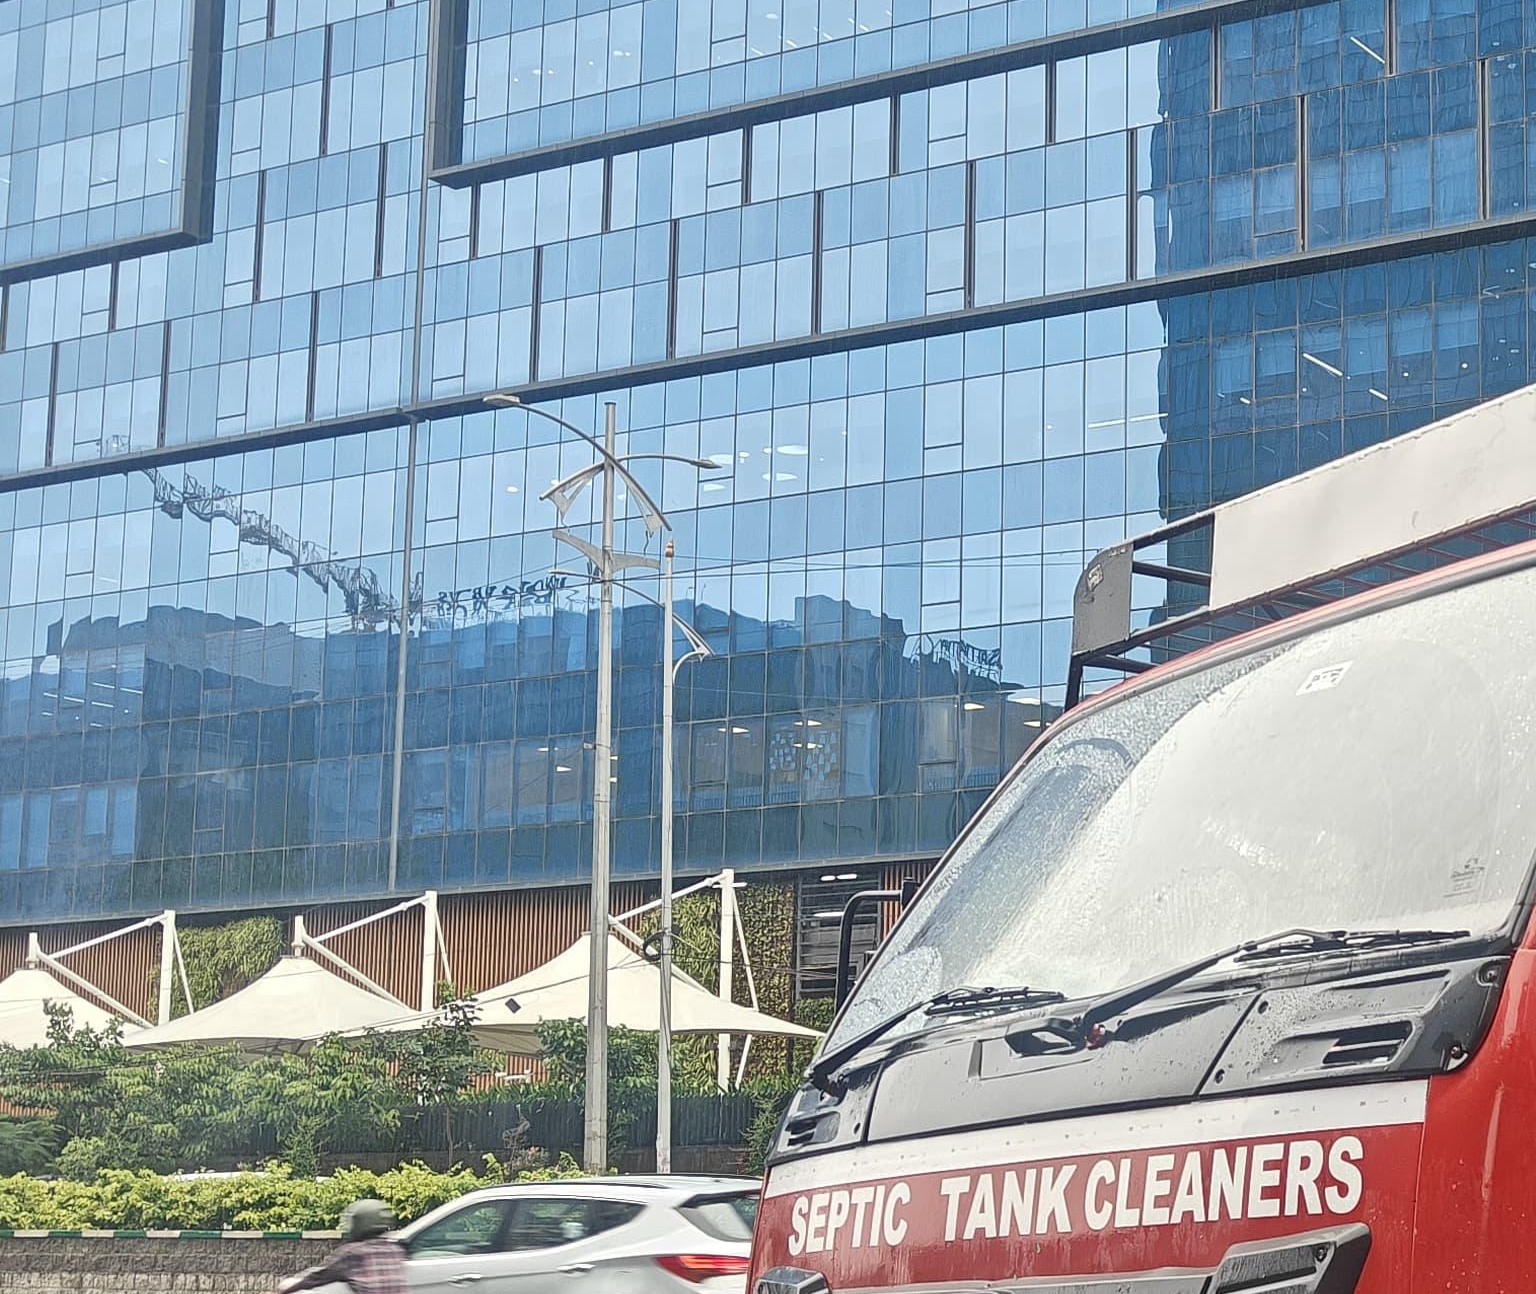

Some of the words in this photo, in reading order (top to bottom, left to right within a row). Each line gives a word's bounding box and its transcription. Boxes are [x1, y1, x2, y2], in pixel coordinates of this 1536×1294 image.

[788, 1182, 911, 1256] SEPTIC
[940, 1164, 1077, 1242] TANK
[1084, 1134, 1364, 1232] CLEANERS
